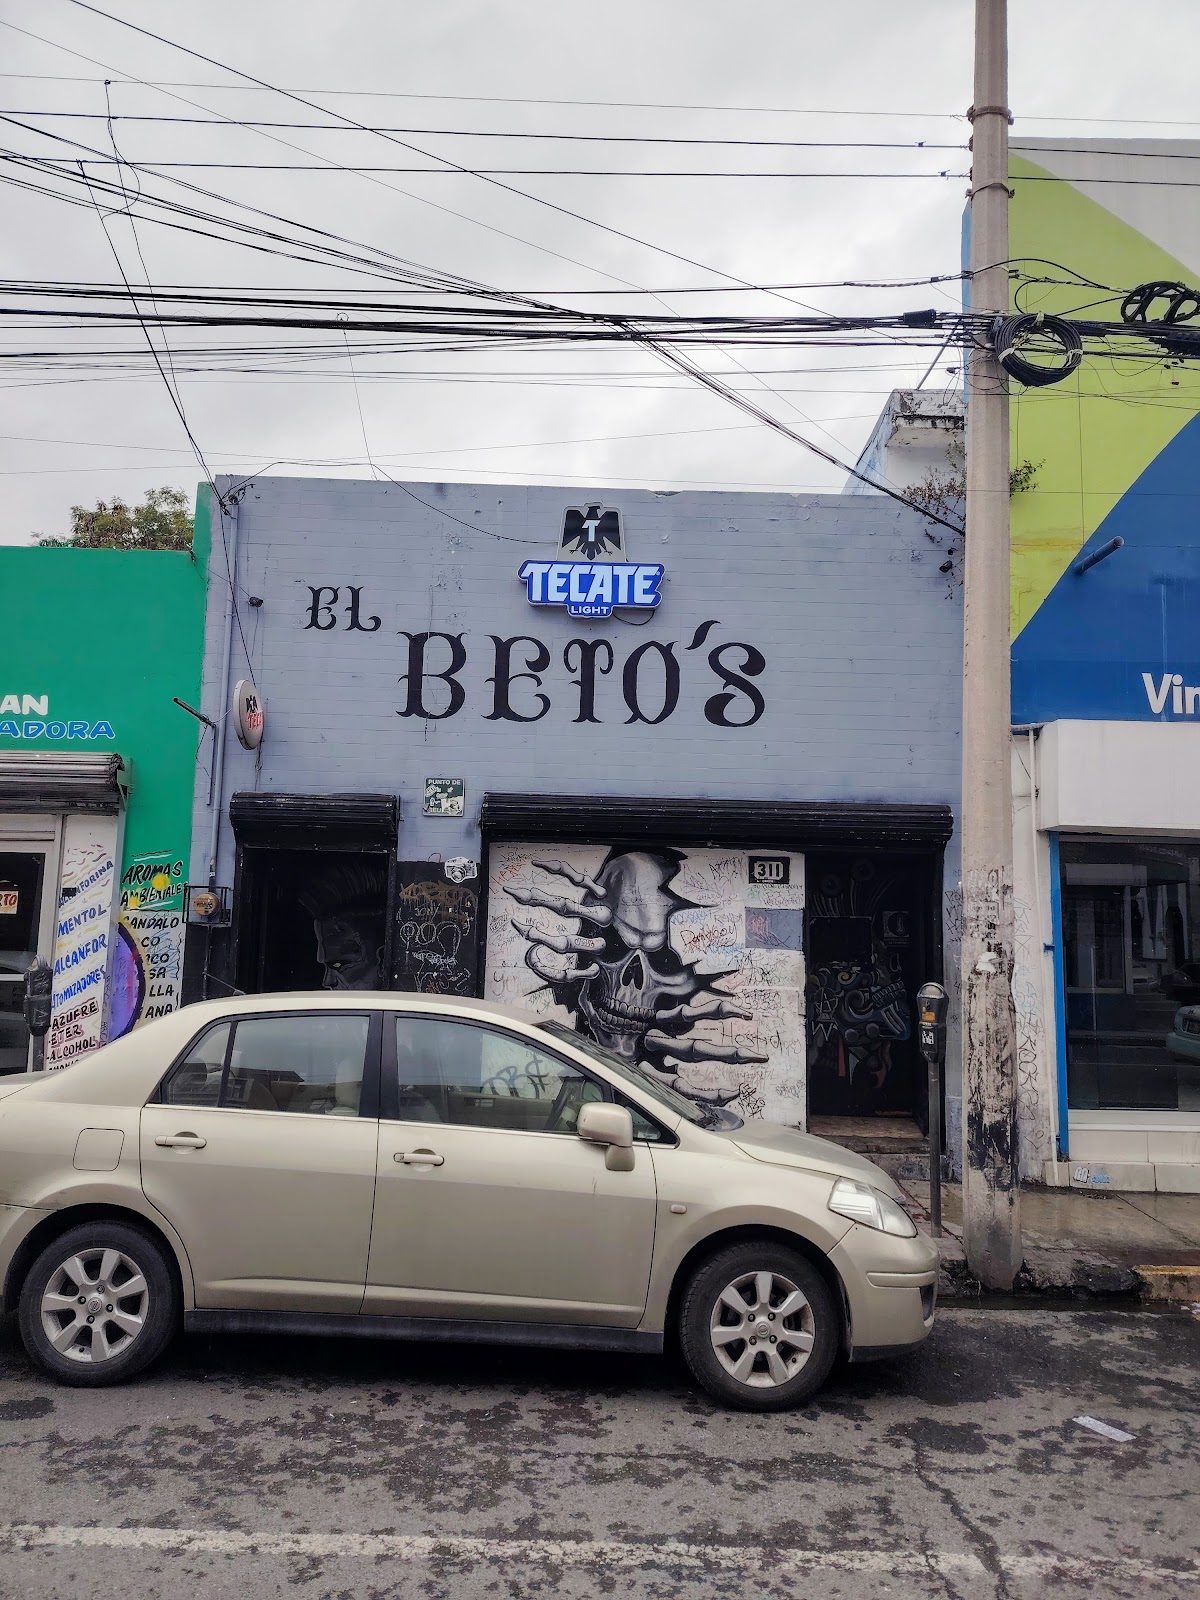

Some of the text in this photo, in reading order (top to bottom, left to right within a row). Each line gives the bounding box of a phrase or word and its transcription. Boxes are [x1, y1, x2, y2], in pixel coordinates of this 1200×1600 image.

[581, 519, 601, 542] T
[520, 563, 658, 604] TECATE
[303, 585, 382, 632] EL
[570, 605, 609, 615] LIGHT
[395, 619, 767, 728] BETO'S
[121, 860, 183, 885] AROMAS
[757, 863, 780, 877] 311
[57, 904, 107, 938] MENTOL
[53, 933, 108, 977] ALCANFOR
